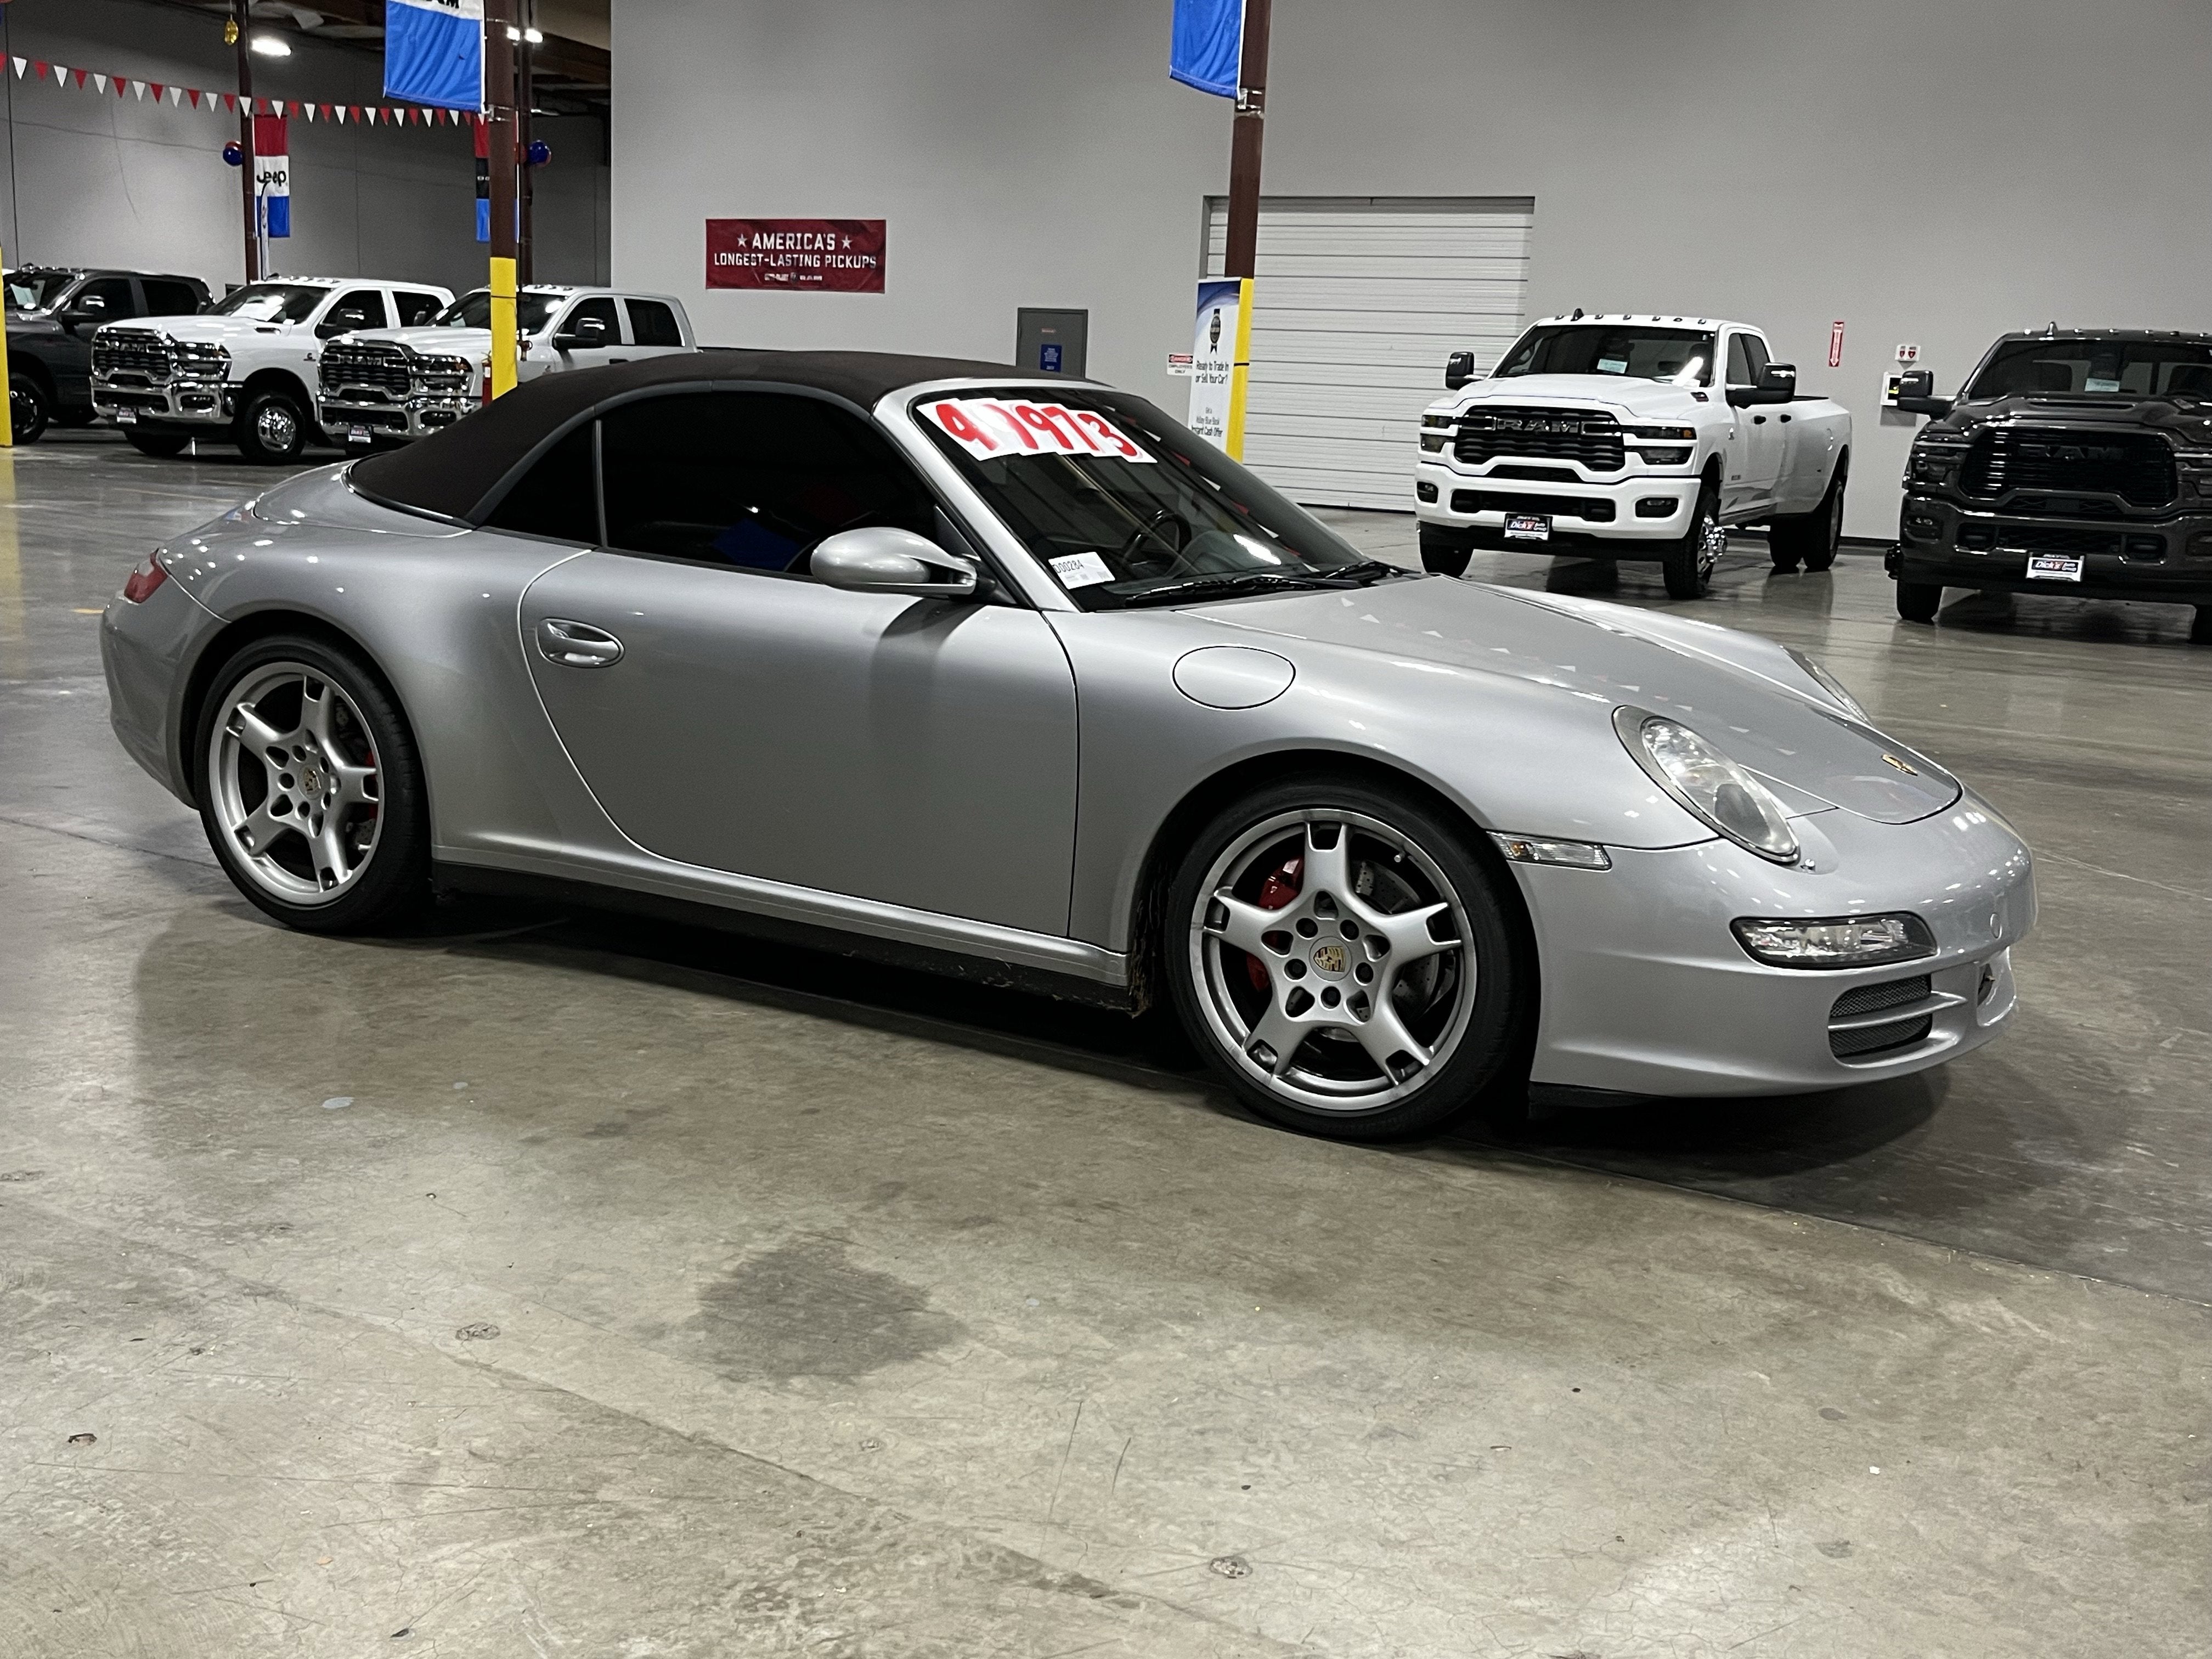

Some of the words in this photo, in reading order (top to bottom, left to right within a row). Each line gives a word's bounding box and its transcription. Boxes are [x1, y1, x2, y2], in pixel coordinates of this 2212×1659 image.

[256, 171, 286, 187] Jeep
[752, 233, 836, 251] AMERICA'S
[714, 252, 821, 268] LONGEST-LASTING
[825, 255, 877, 269] PICKUPS
[1497, 417, 1578, 433] RAM
